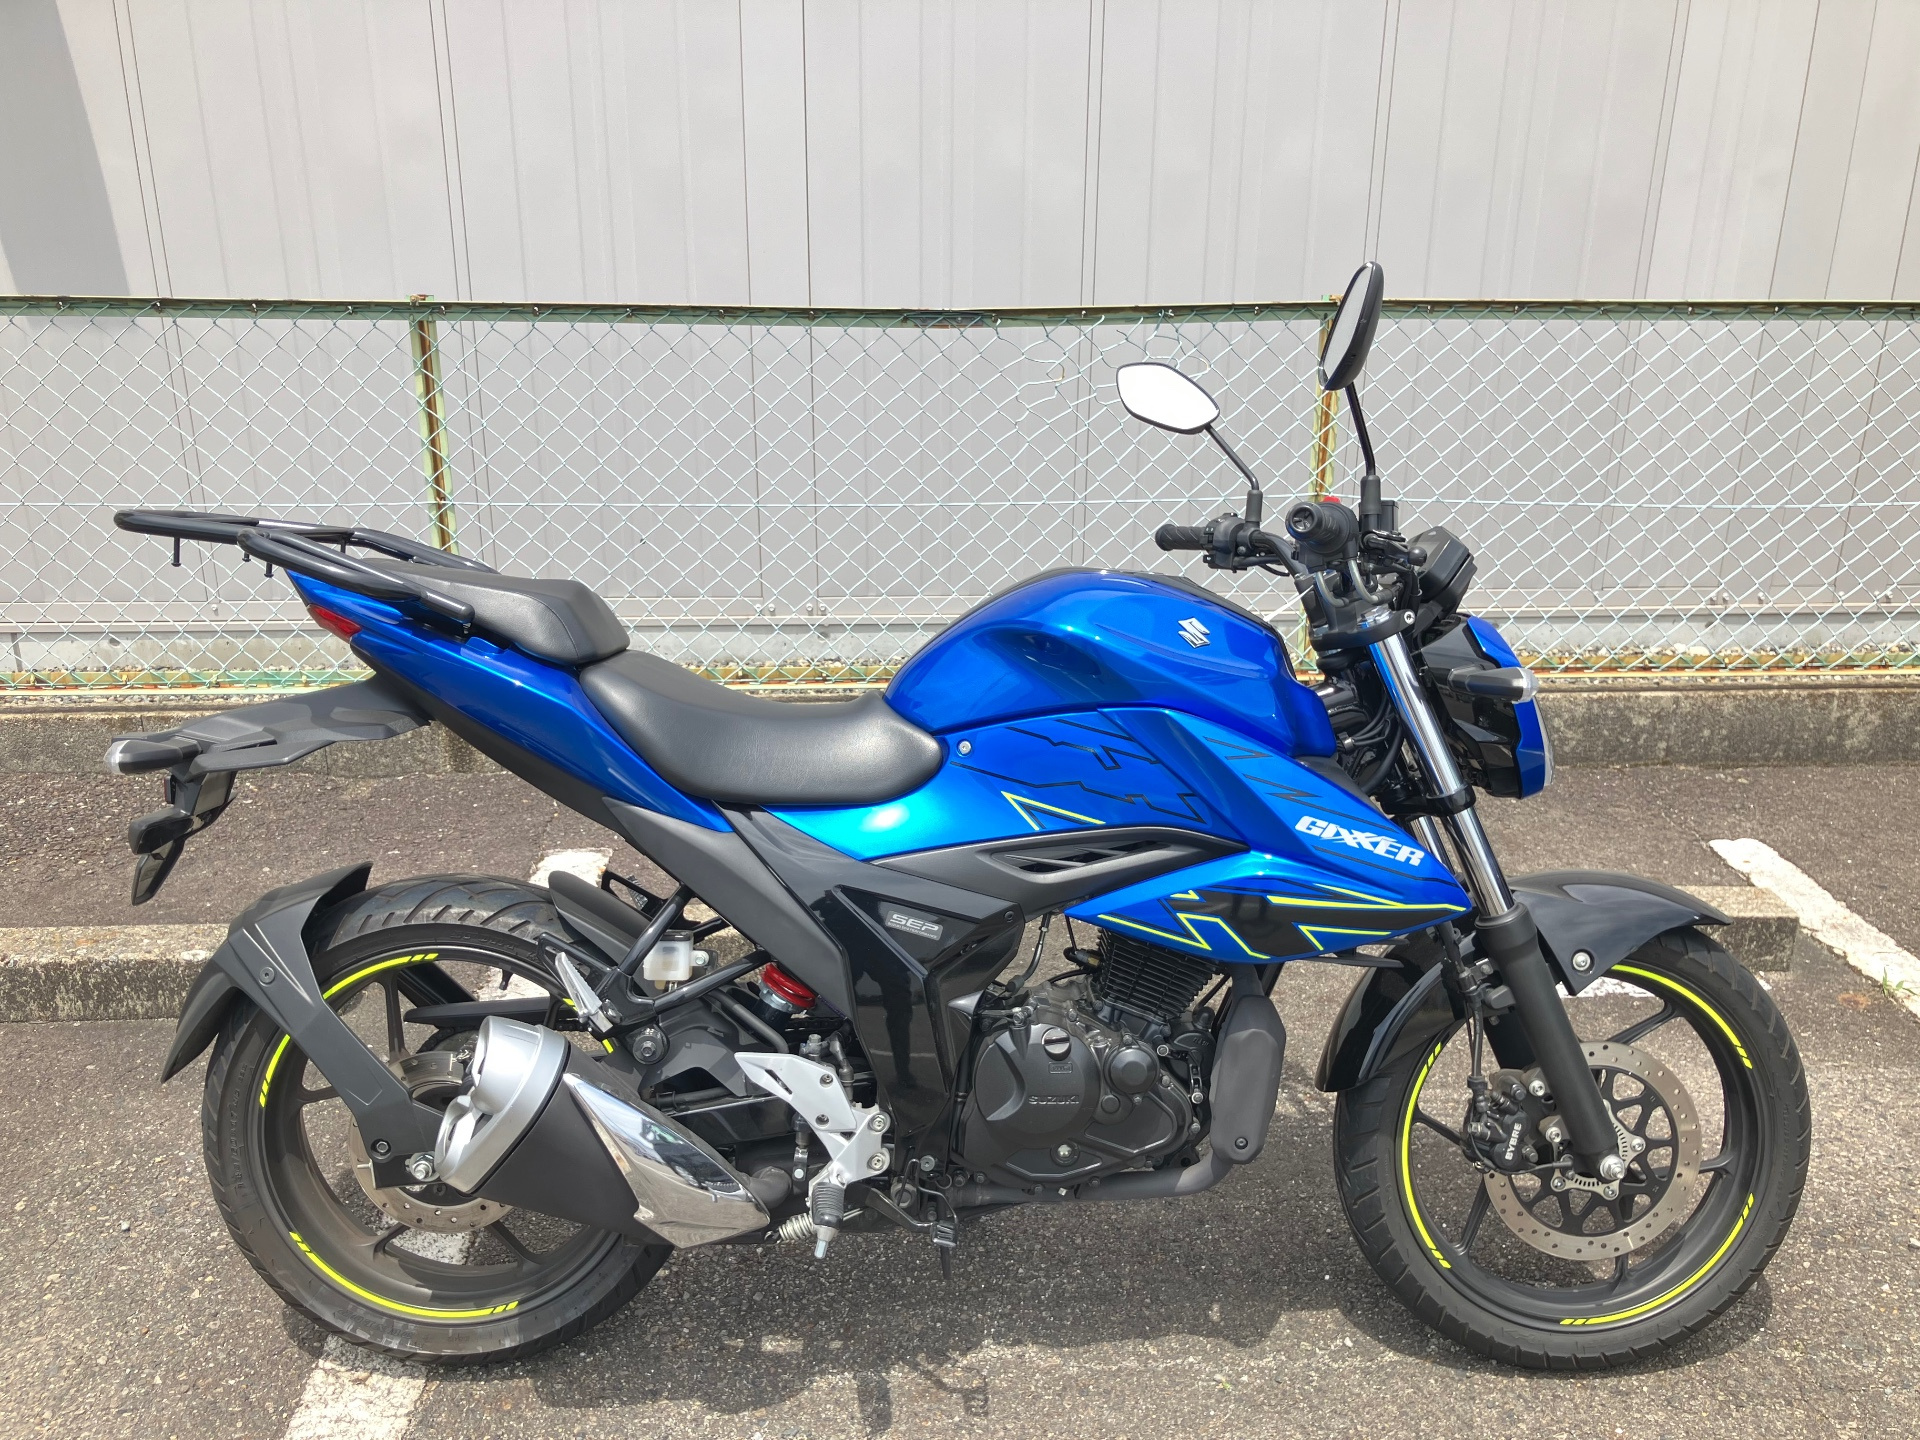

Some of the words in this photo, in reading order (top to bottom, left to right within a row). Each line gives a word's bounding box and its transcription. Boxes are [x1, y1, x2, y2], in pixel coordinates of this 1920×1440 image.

[1294, 815, 1425, 867] GIXXER
[890, 913, 939, 931] SEP
[1028, 1096, 1080, 1105] SUZUKI
[1504, 1122, 1522, 1161] BYBRE
